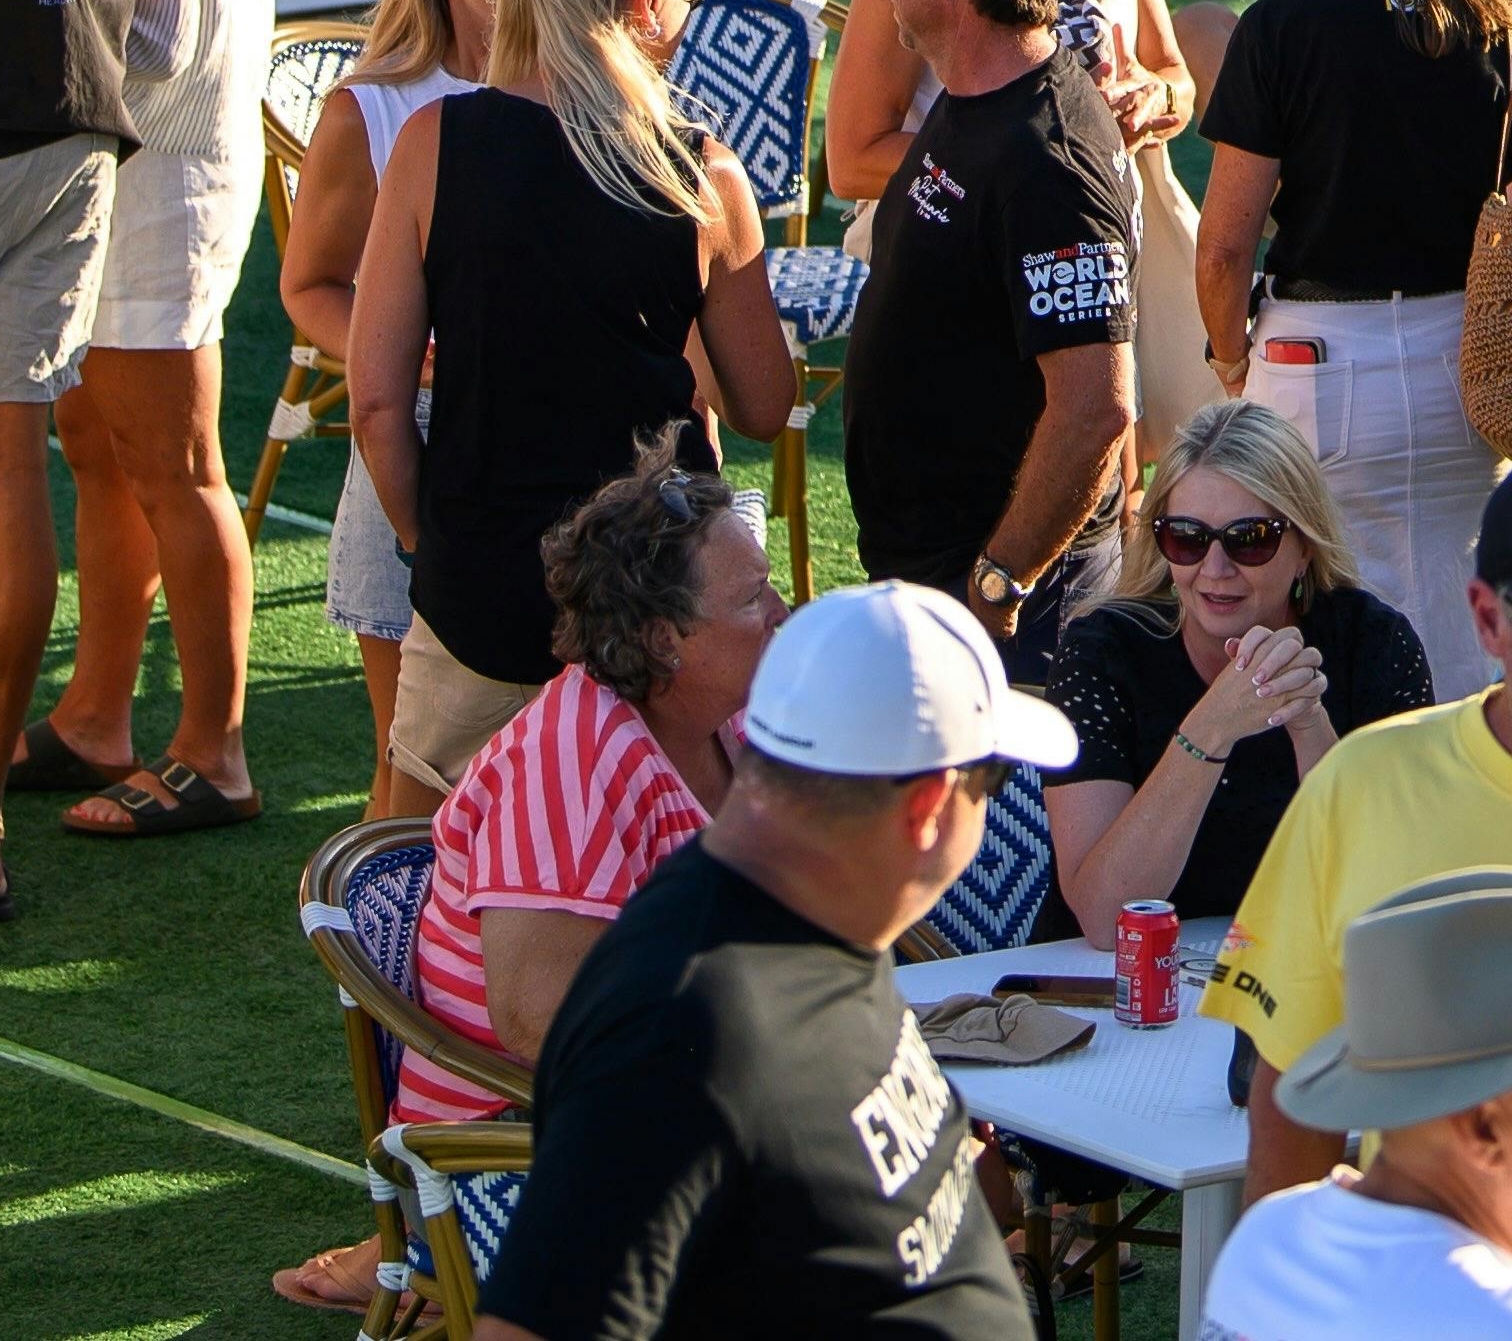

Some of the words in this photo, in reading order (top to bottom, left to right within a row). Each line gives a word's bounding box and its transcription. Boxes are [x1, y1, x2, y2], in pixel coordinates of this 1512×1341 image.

[1024, 254, 1128, 293] WORLD
[1030, 280, 1130, 316] OCEAN
[1059, 307, 1112, 323] SERIES
[1234, 970, 1278, 1019] ONE
